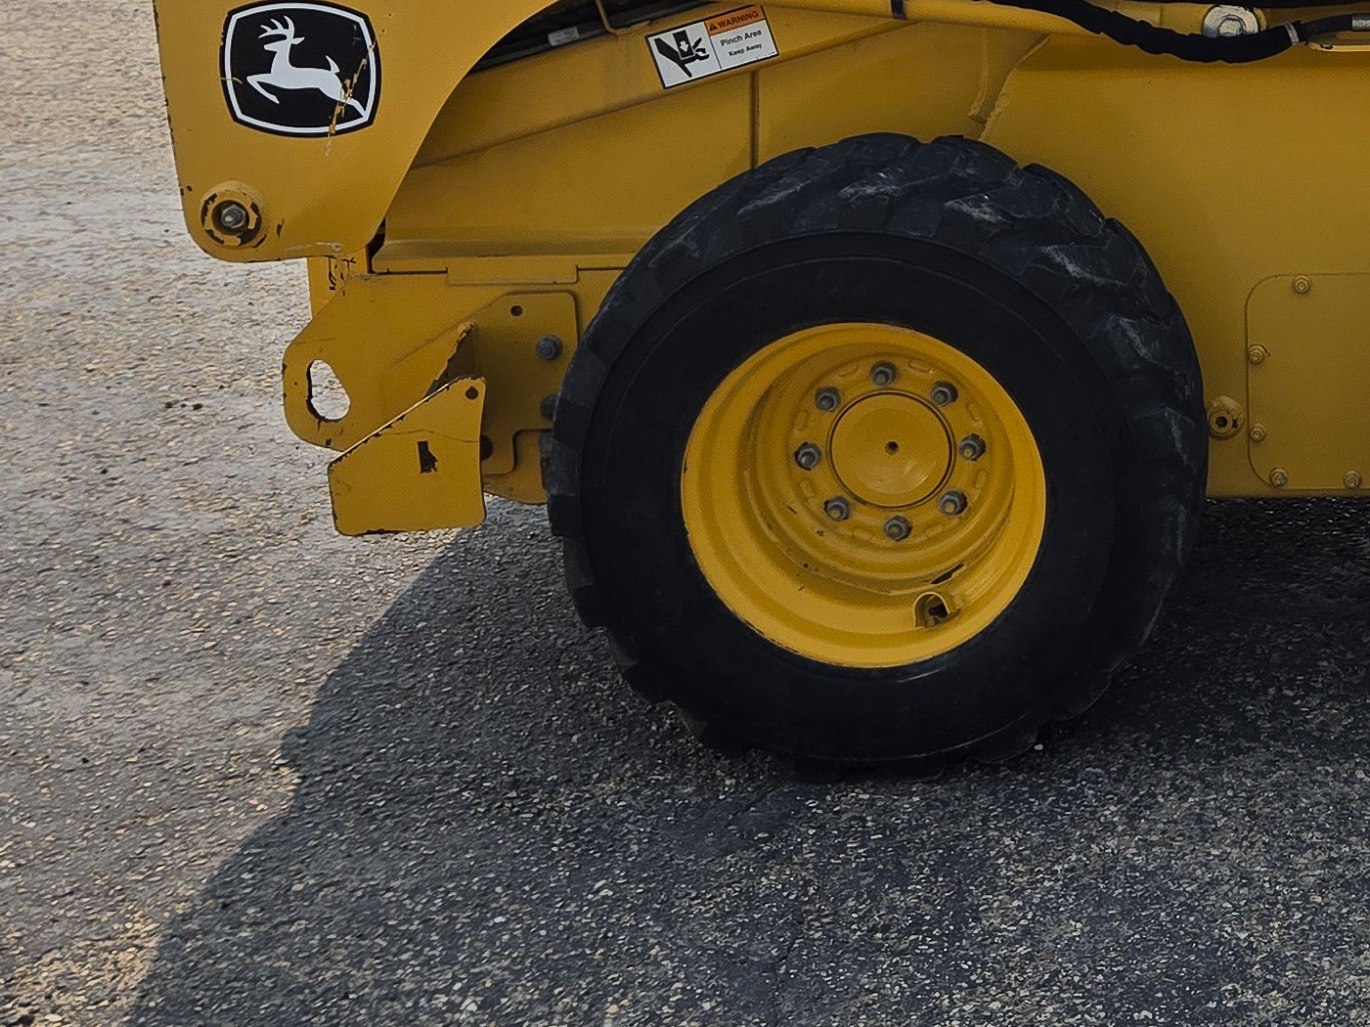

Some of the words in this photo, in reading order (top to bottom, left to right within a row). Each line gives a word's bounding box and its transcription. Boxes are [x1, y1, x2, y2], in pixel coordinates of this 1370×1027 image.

[717, 11, 760, 29] WARNING
[720, 34, 743, 47] Pinch
[744, 28, 763, 40] Area
[728, 47, 745, 57] Keep
[745, 42, 763, 53] Away
